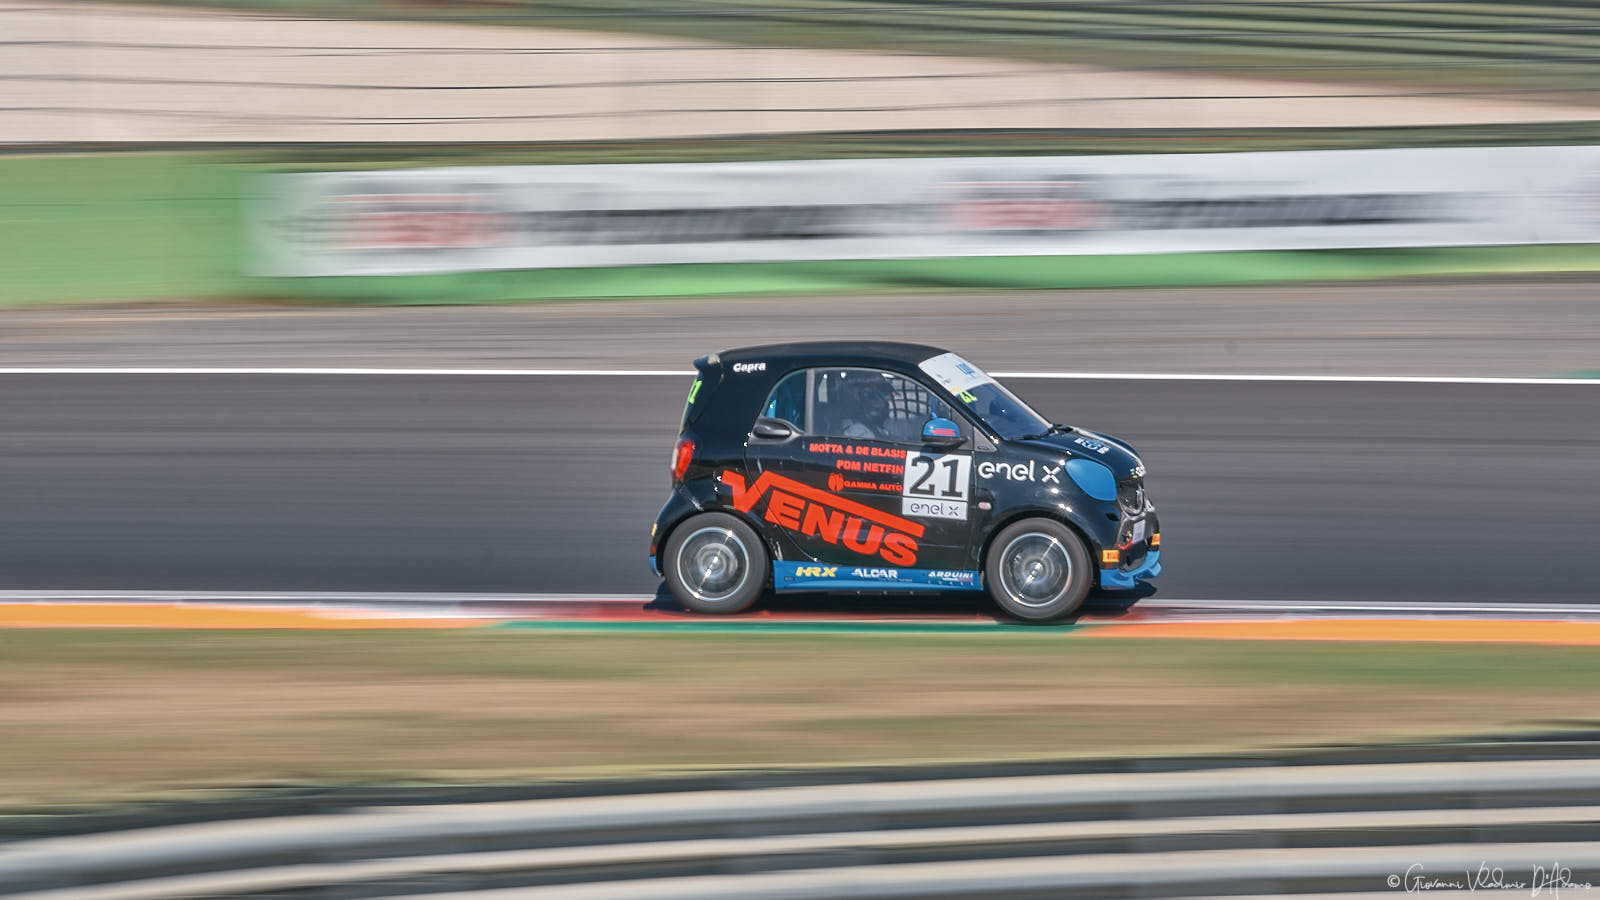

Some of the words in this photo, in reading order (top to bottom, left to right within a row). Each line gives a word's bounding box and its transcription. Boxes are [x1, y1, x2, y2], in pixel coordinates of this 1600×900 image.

[732, 362, 767, 374] Capra
[809, 443, 844, 454] MOTTA
[845, 445, 853, 454] &
[855, 446, 869, 456] DE
[870, 447, 907, 459] BLASIS
[863, 462, 904, 475] NETFIN
[977, 461, 1036, 482] enel
[909, 455, 963, 497] 21
[843, 481, 877, 490] GAMMA
[878, 483, 903, 492] AUTO
[910, 503, 945, 515] enel
[721, 469, 925, 567] VENUS
[795, 566, 838, 577] HRX
[850, 568, 898, 579] ALCAR
[928, 570, 974, 578] ARDUINI
